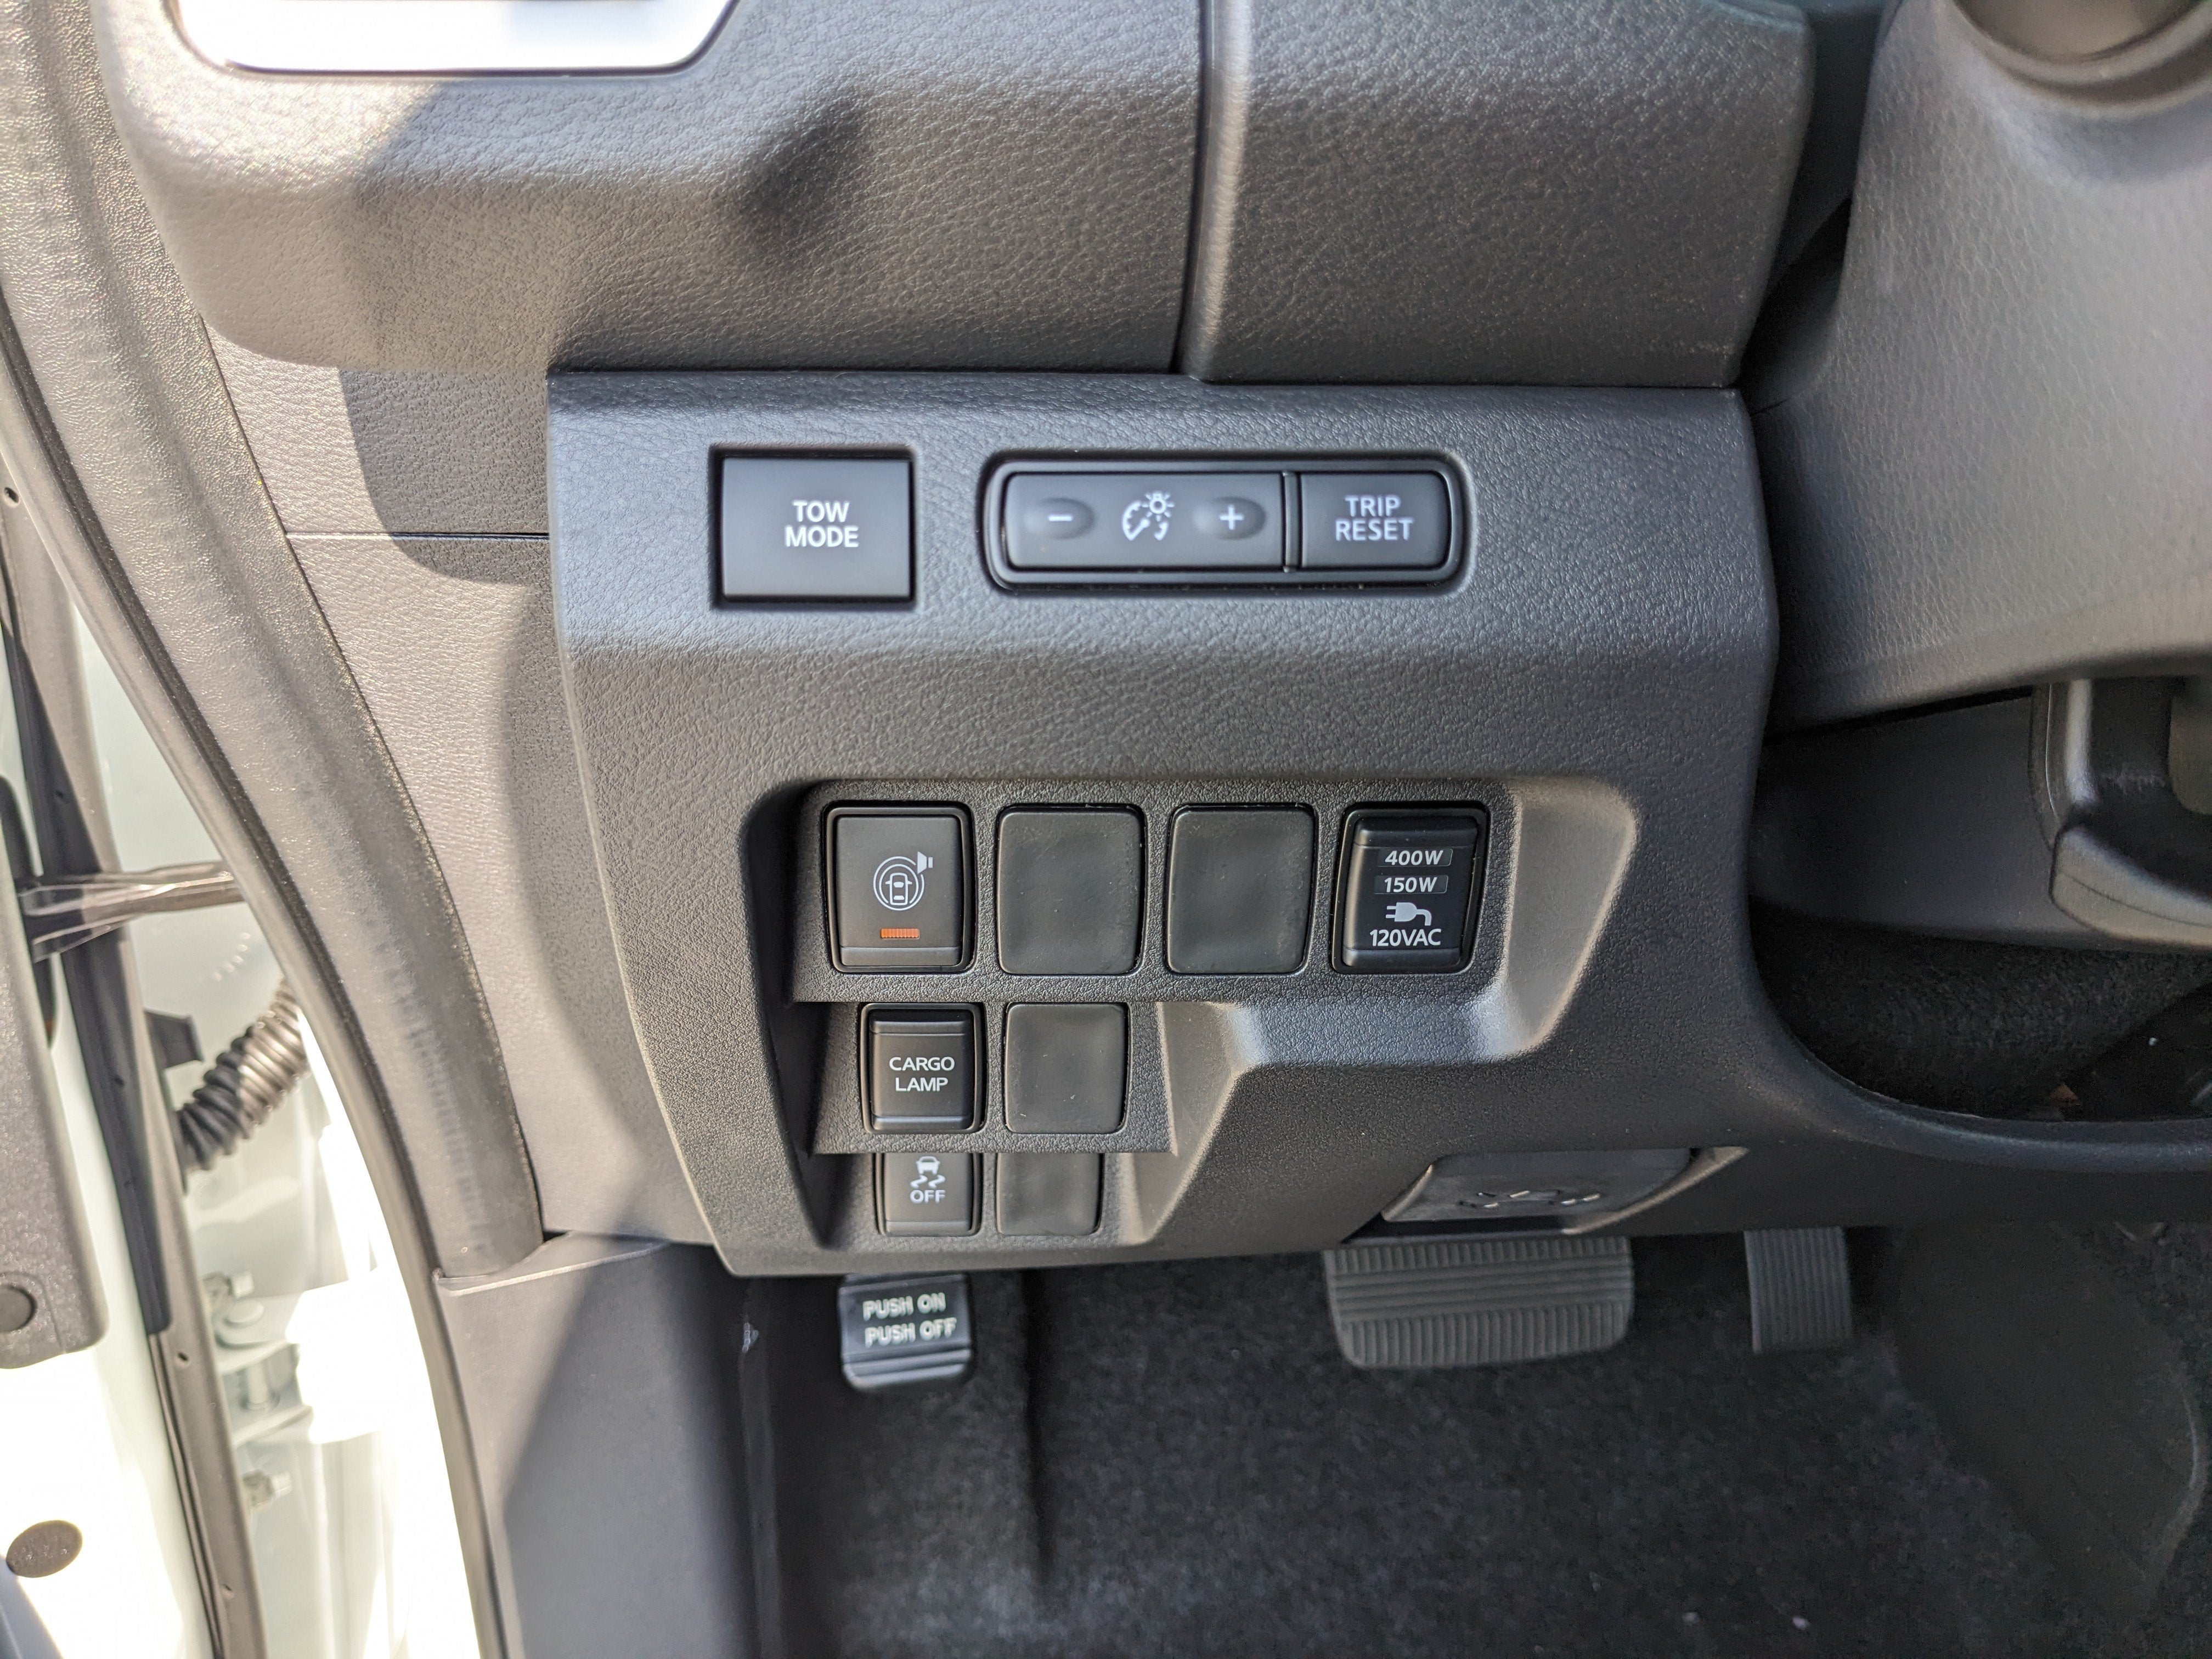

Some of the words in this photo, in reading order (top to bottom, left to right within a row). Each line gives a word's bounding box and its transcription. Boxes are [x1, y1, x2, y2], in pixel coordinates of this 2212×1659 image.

[793, 500, 849, 522] TOW
[1345, 495, 1401, 516] TRIP
[785, 525, 859, 548] MODE
[1335, 517, 1414, 541] RESET
[1385, 850, 1443, 865] 400W
[1384, 877, 1437, 893] 150W
[1370, 928, 1441, 946] 120VAC
[889, 1057, 955, 1070] CARGO
[895, 1077, 948, 1091] LAMP
[910, 1189, 946, 1203] OFF
[863, 1296, 913, 1321] PUSH
[917, 1292, 946, 1313] ON
[865, 1323, 916, 1348] PUSH
[919, 1317, 957, 1340] OFF
